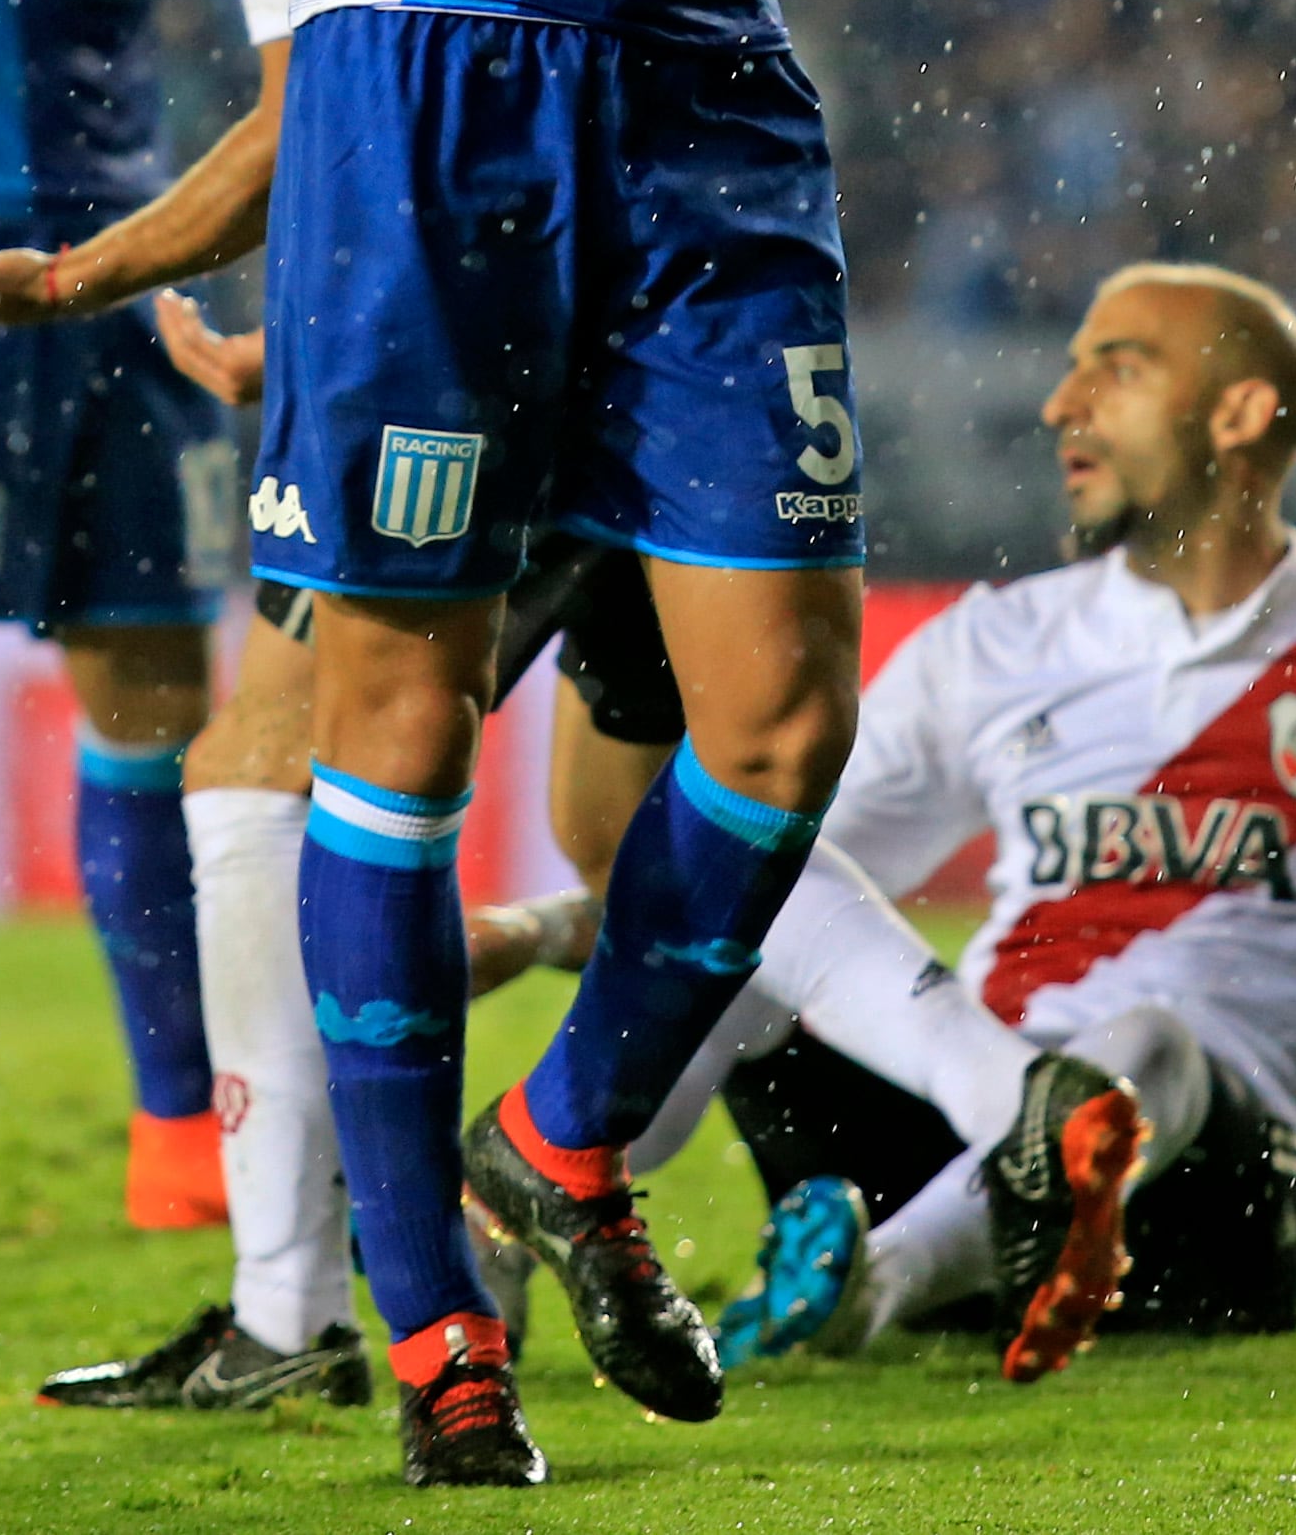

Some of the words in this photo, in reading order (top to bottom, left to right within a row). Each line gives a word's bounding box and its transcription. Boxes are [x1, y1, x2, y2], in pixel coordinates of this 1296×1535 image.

[782, 344, 854, 485] 5
[391, 436, 472, 457] RACING
[776, 492, 864, 521] Kapp
